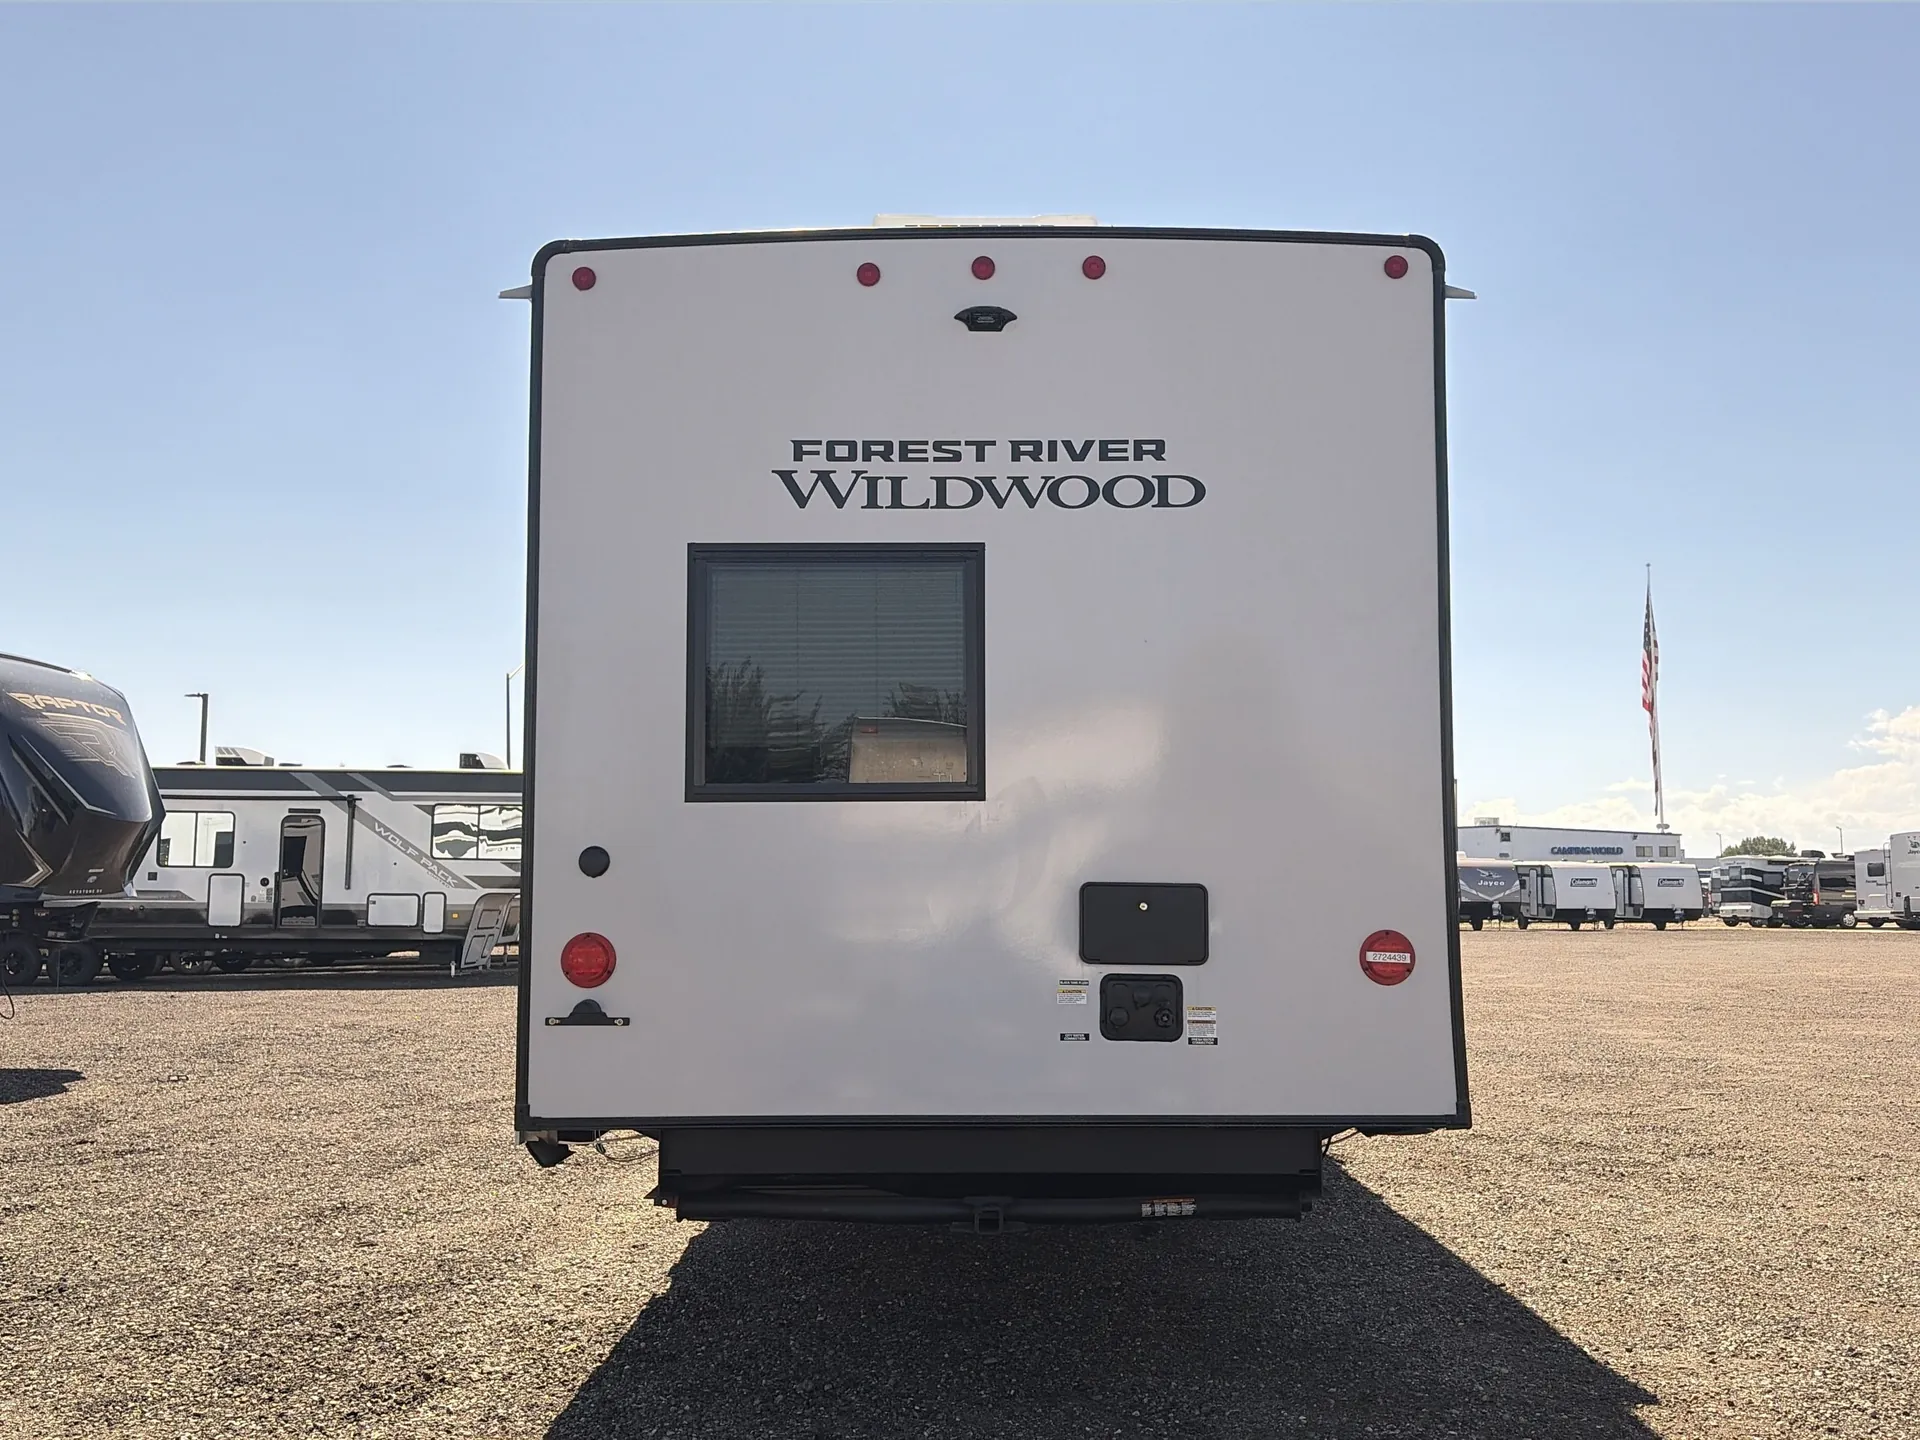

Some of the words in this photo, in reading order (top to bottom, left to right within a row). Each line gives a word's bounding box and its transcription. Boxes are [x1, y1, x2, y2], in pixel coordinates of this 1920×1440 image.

[790, 439, 997, 463] FOREST
[1008, 438, 1167, 462] RIVER
[771, 468, 1207, 510] WILDWOOD
[5, 691, 127, 726] RAPTOR
[374, 822, 419, 858] WOLF
[420, 857, 459, 888] PACK
[1550, 846, 1591, 855] CAMPING
[1591, 846, 1623, 855] WORLD
[1372, 953, 1407, 961] 2724439
